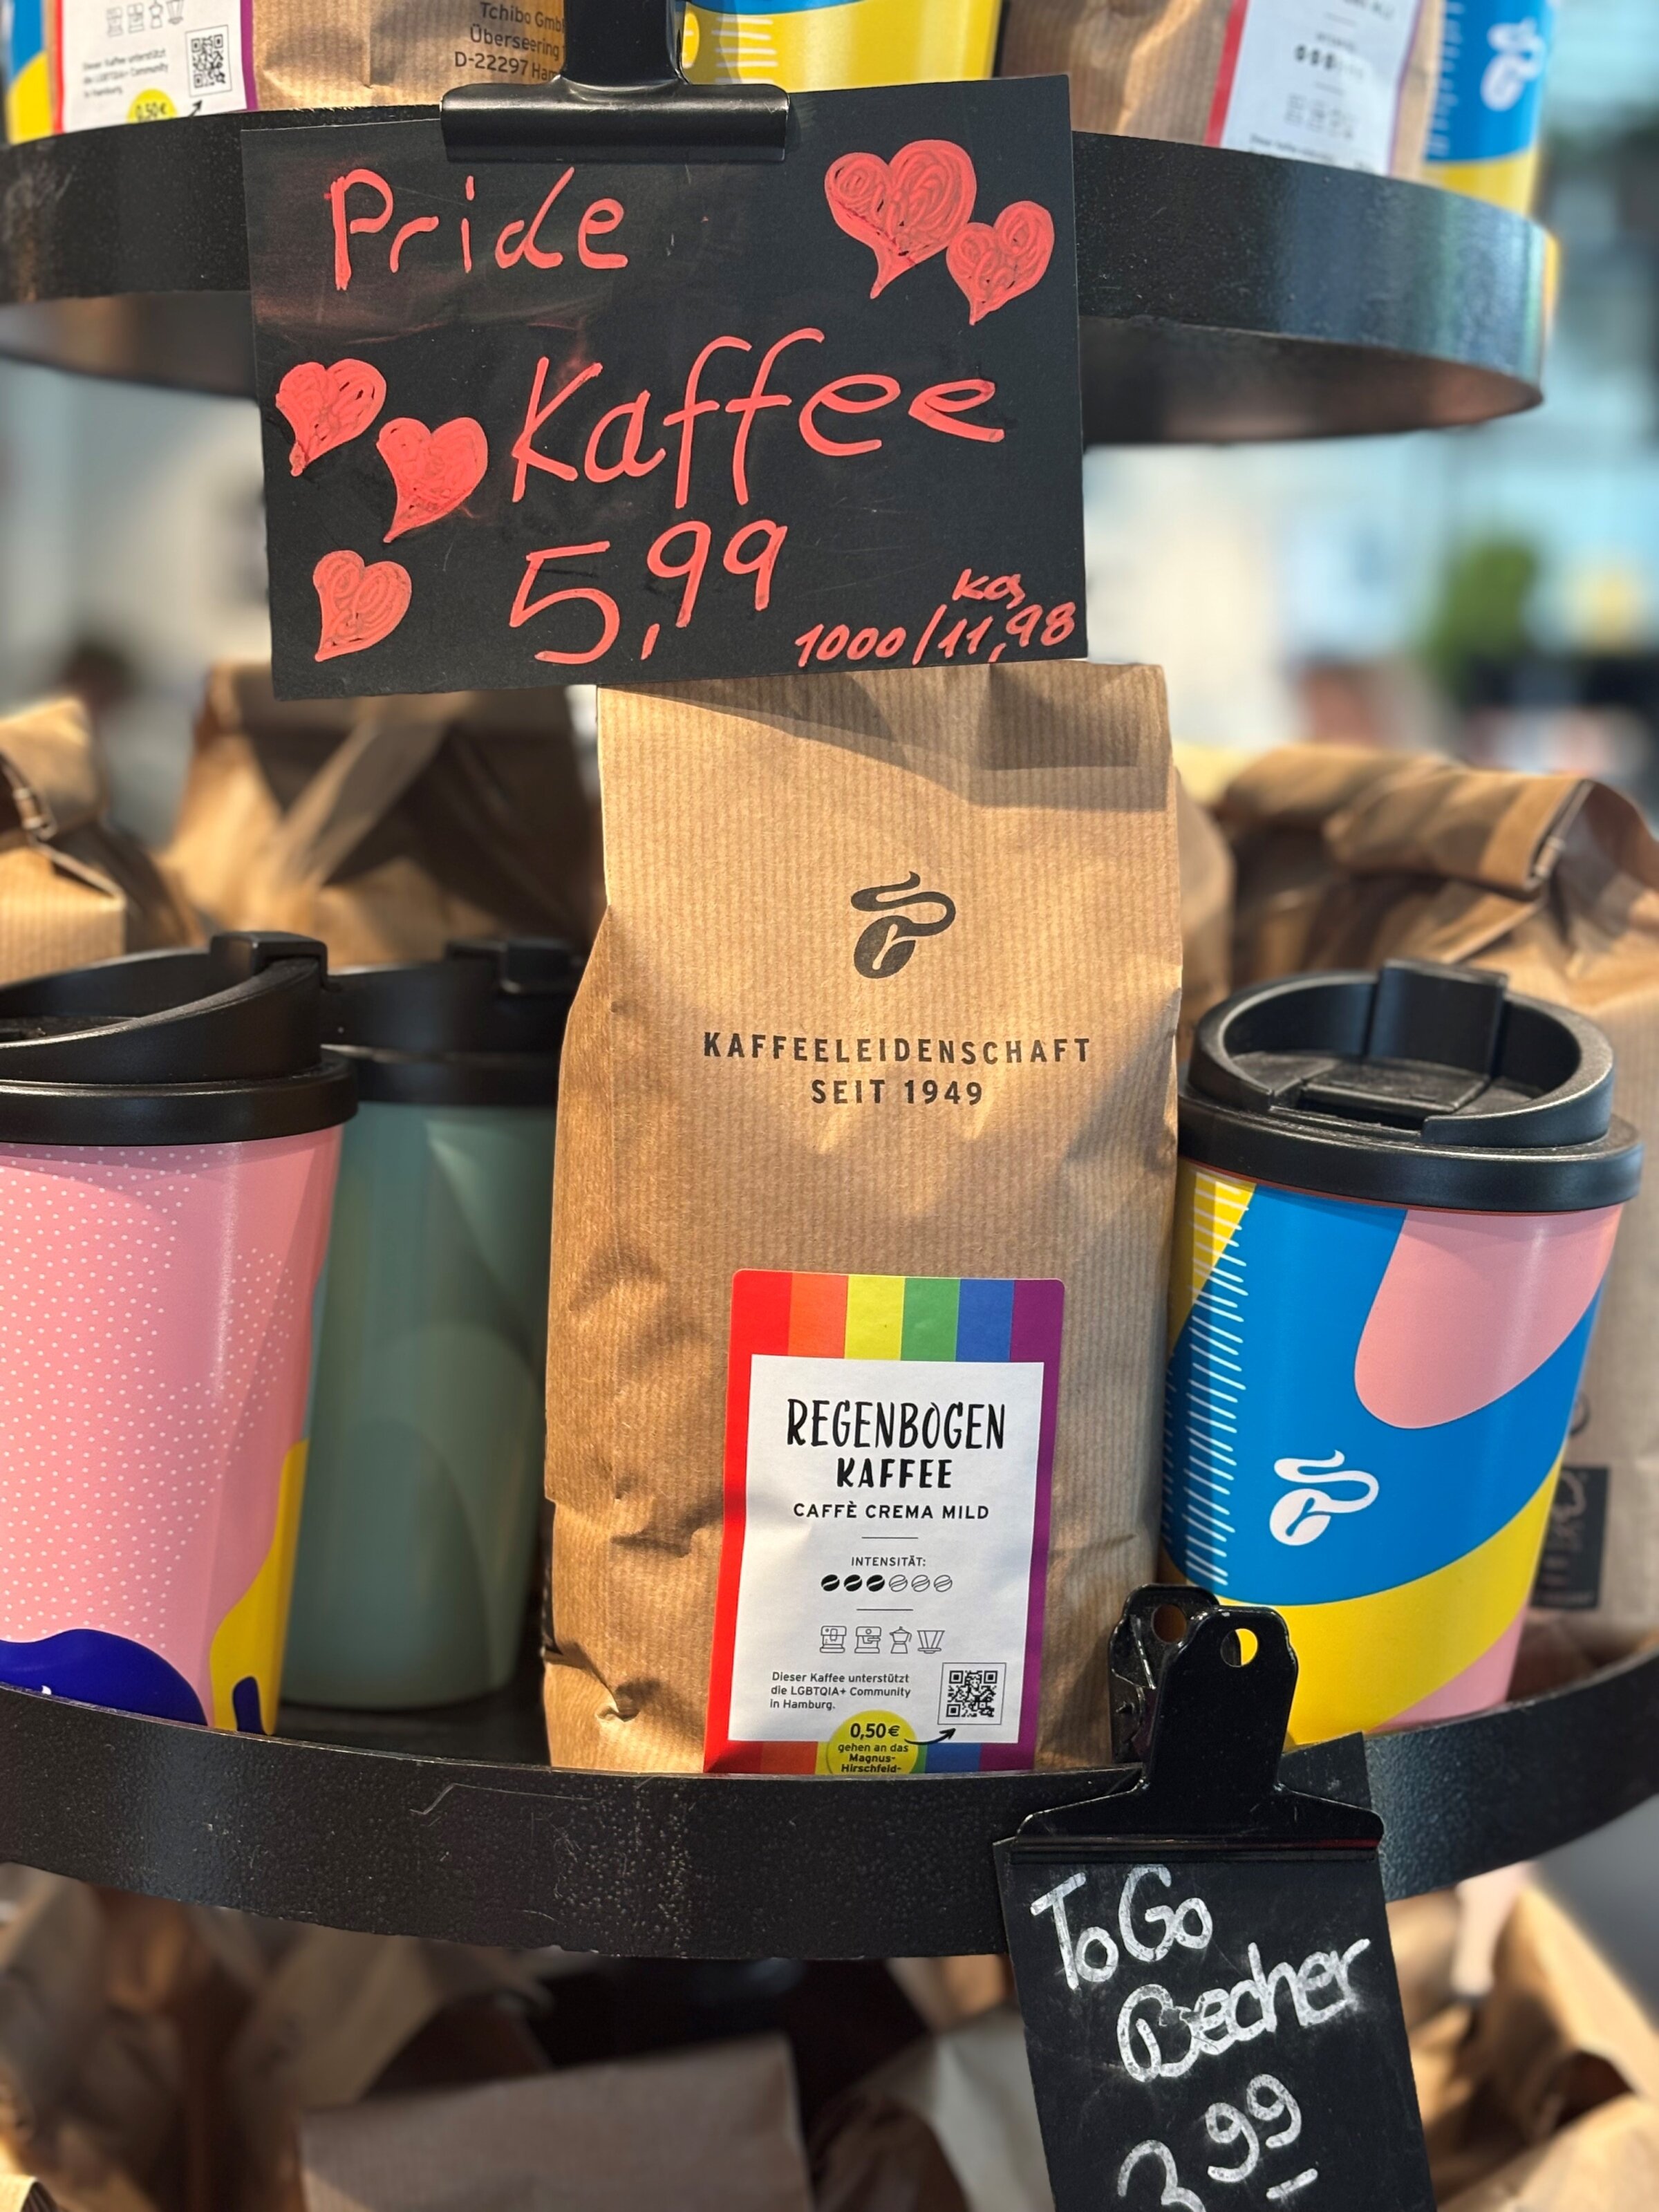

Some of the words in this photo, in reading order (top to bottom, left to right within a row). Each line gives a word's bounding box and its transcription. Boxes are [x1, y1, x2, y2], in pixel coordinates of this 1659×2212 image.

[480, 2, 531, 24] Tchibo
[470, 24, 559, 60] Überseering
[455, 51, 529, 75] D-22297
[326, 167, 628, 290] Pride
[512, 328, 1005, 509] Kaffee
[509, 519, 788, 664] 5,99
[704, 1031, 1090, 1065] KAFFEELEIDENSCHAFT
[812, 1079, 885, 1105] SEIT
[904, 1079, 983, 1106] 1949
[787, 1398, 1005, 1450] REGENBOGEN
[836, 1457, 953, 1488] KAFFEE
[794, 1501, 857, 1519] CAFFÈ
[865, 1504, 934, 1519] CREMA
[942, 1505, 989, 1519] MILD
[851, 1555, 926, 1567] INTENSITÄT:
[771, 1671, 807, 1682] Dieser
[810, 1673, 845, 1683] Kaffee
[848, 1674, 910, 1683] unterstützt
[771, 1685, 787, 1695] die
[790, 1686, 846, 1696] LGBTQIA+
[850, 1687, 911, 1698] Community
[770, 1699, 780, 1708] in
[783, 1700, 836, 1711] Hamburg.
[838, 1743, 871, 1753] gehen
[890, 1743, 909, 1752] das
[849, 1754, 896, 1763] Magnus-
[841, 1763, 901, 1773] Hirschfeld-
[1116, 1938, 1370, 2082] Becher
